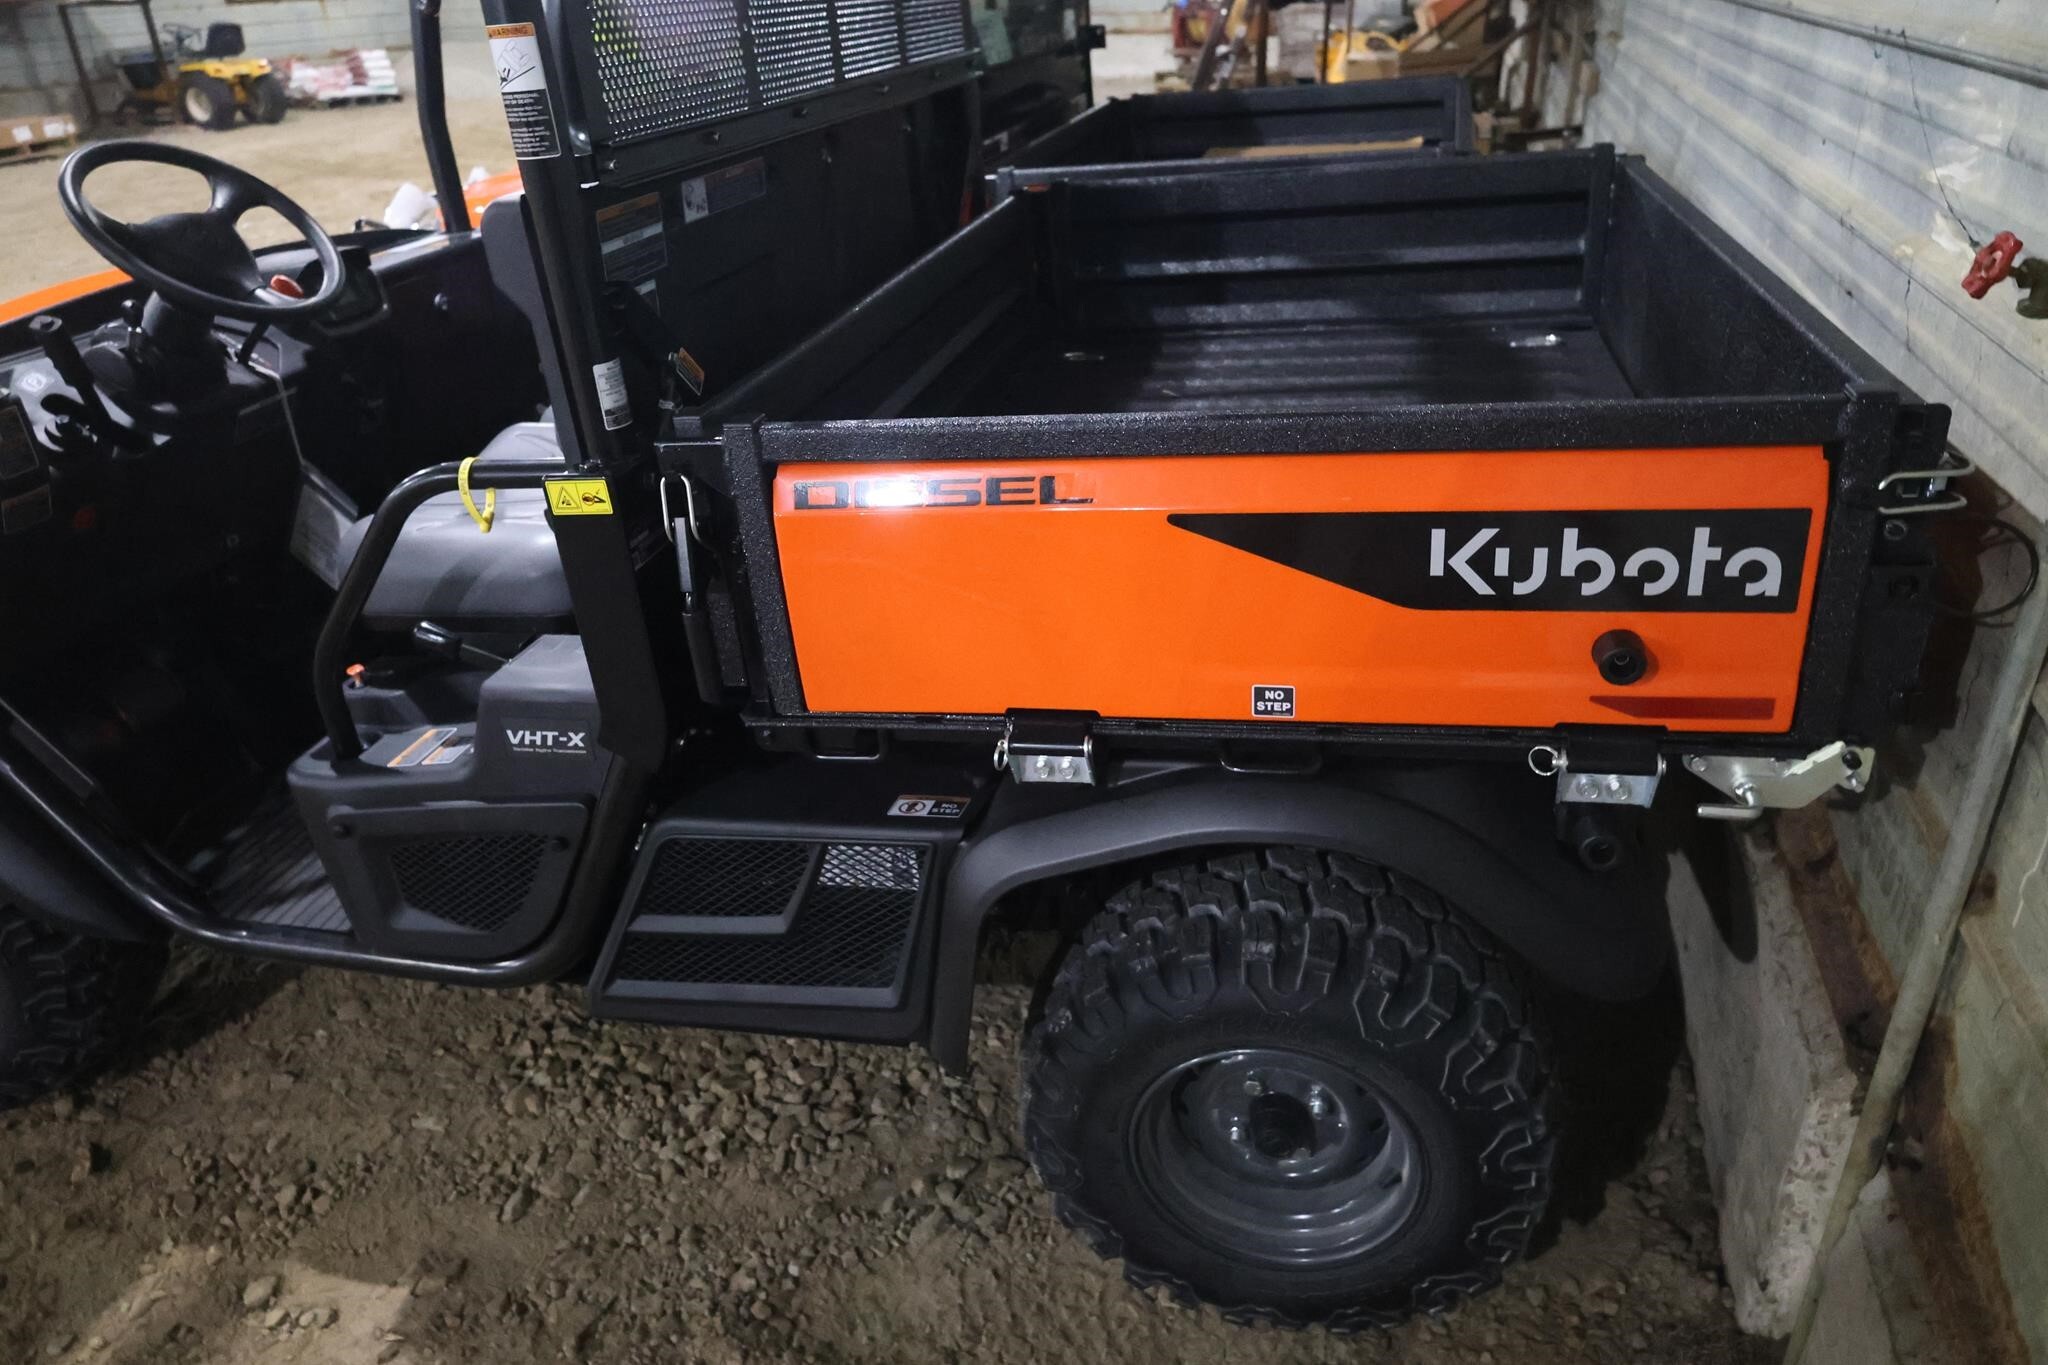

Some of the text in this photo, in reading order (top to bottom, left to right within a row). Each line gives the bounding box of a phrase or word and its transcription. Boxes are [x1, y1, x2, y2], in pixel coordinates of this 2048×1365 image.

[793, 476, 1094, 510] DISEL
[1429, 527, 1782, 596] Kubota
[1264, 690, 1285, 700] NO
[1256, 701, 1291, 711] STEP
[506, 729, 586, 747] VHT-X
